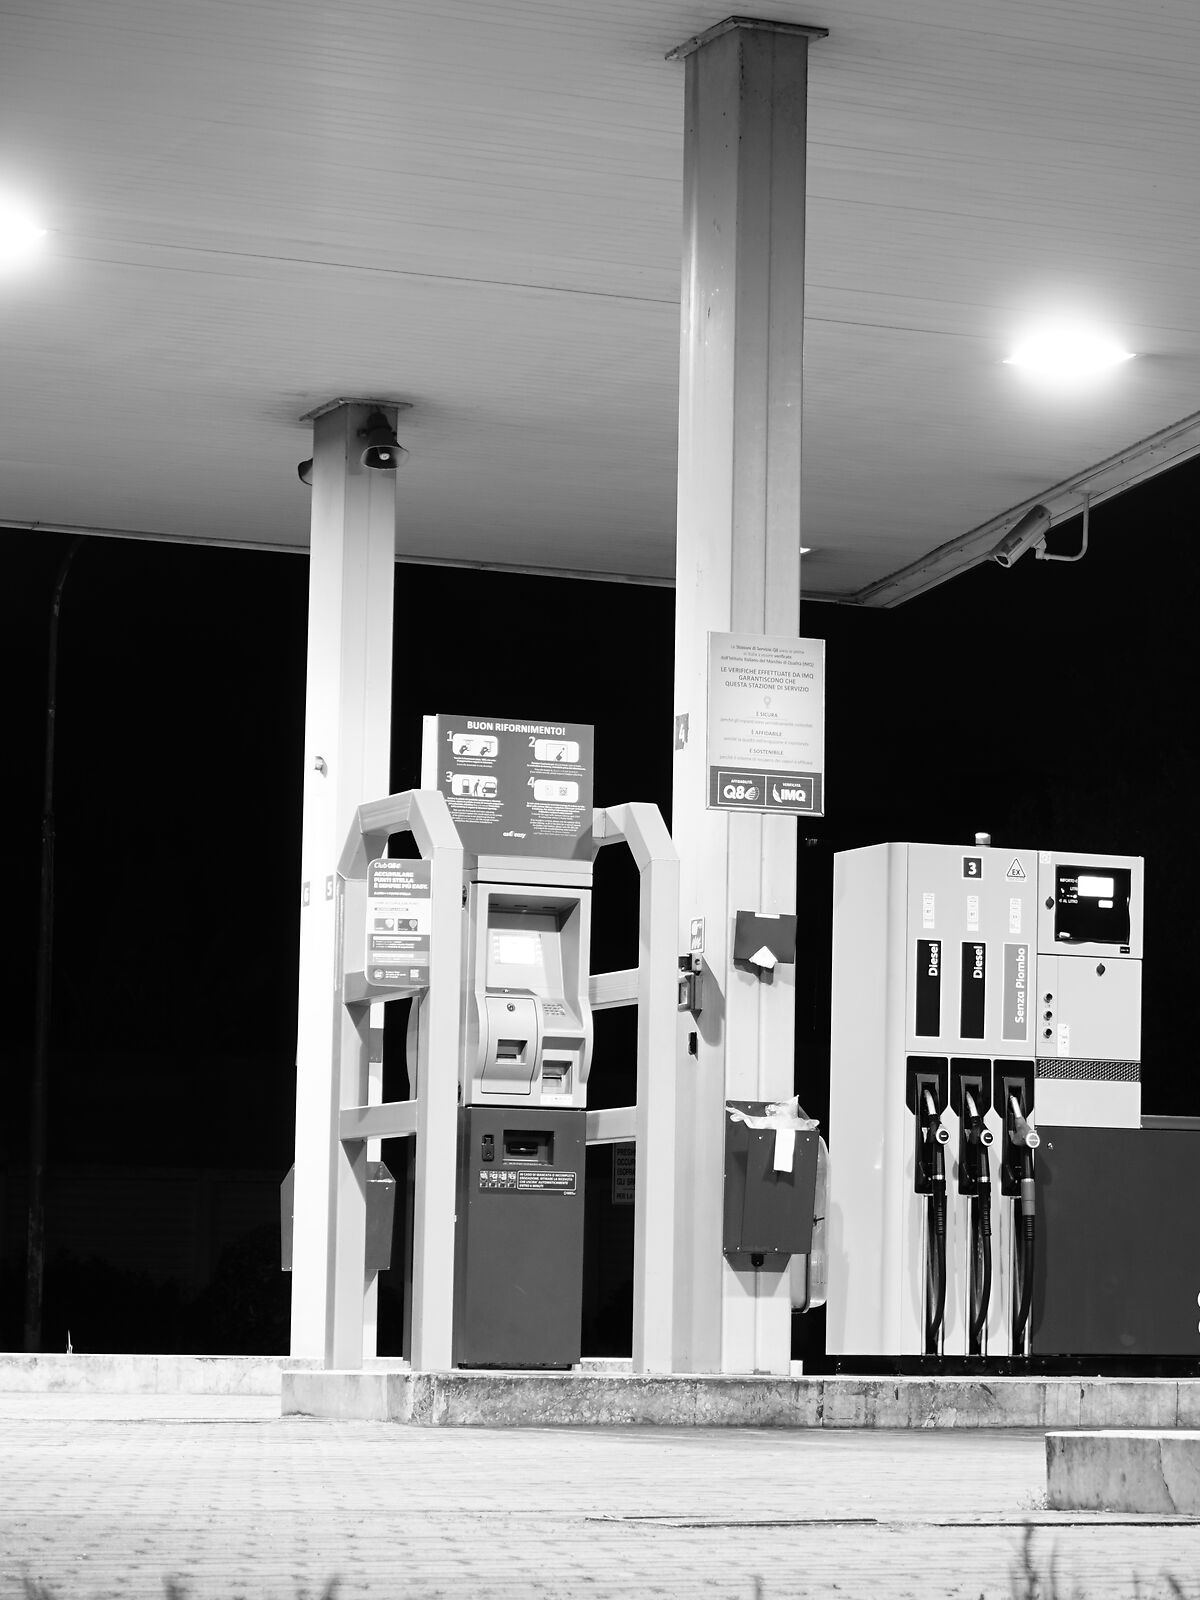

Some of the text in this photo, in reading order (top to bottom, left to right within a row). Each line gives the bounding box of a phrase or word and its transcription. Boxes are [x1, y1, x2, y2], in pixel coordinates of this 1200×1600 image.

[728, 667, 756, 675] VERIFICHE
[758, 669, 791, 677] EFFETTUATE
[739, 675, 784, 684] GARANTISCONO
[748, 682, 777, 690] STAZIONE
[784, 685, 810, 693] SERVIZIO
[467, 720, 566, 736] BUON RIFORNIMENTO!
[446, 731, 453, 742] 1
[528, 736, 536, 748] 2
[445, 771, 453, 782] 3
[527, 776, 535, 789] 4
[723, 785, 745, 799] Q8
[780, 789, 806, 802] IMQ
[968, 862, 977, 875] 3
[928, 943, 938, 976] Diesel
[973, 945, 983, 979] Diesel
[1015, 948, 1025, 1023] Senza Piombo
